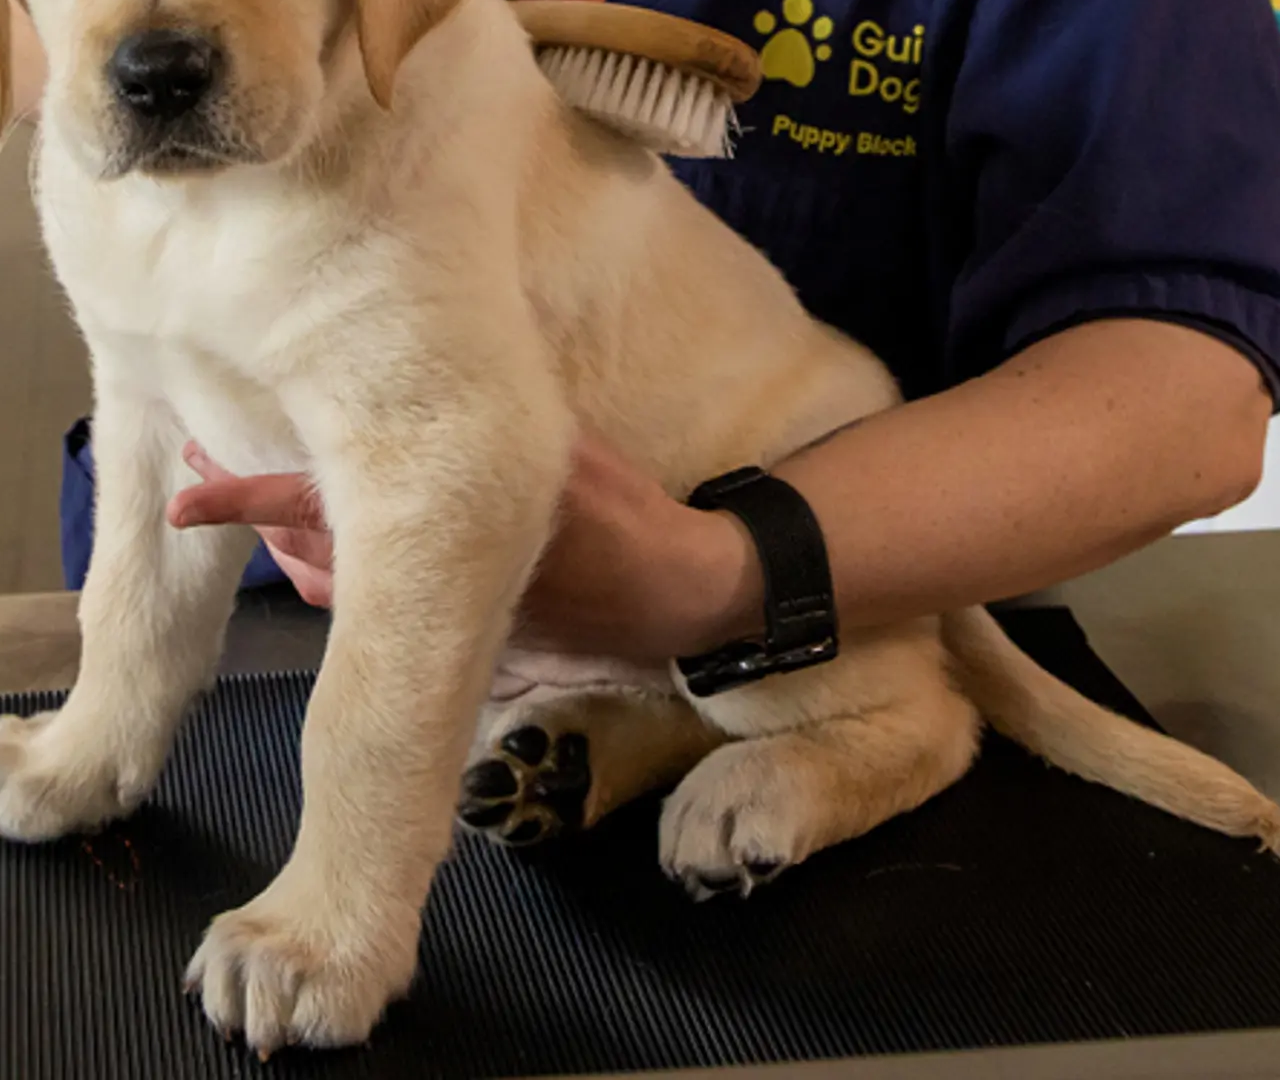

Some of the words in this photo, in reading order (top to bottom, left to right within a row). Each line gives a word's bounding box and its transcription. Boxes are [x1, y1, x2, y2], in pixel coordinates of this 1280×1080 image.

[852, 20, 925, 63] Gui
[848, 59, 921, 113] Dog
[773, 114, 851, 156] Puppy
[857, 132, 917, 156] Block
